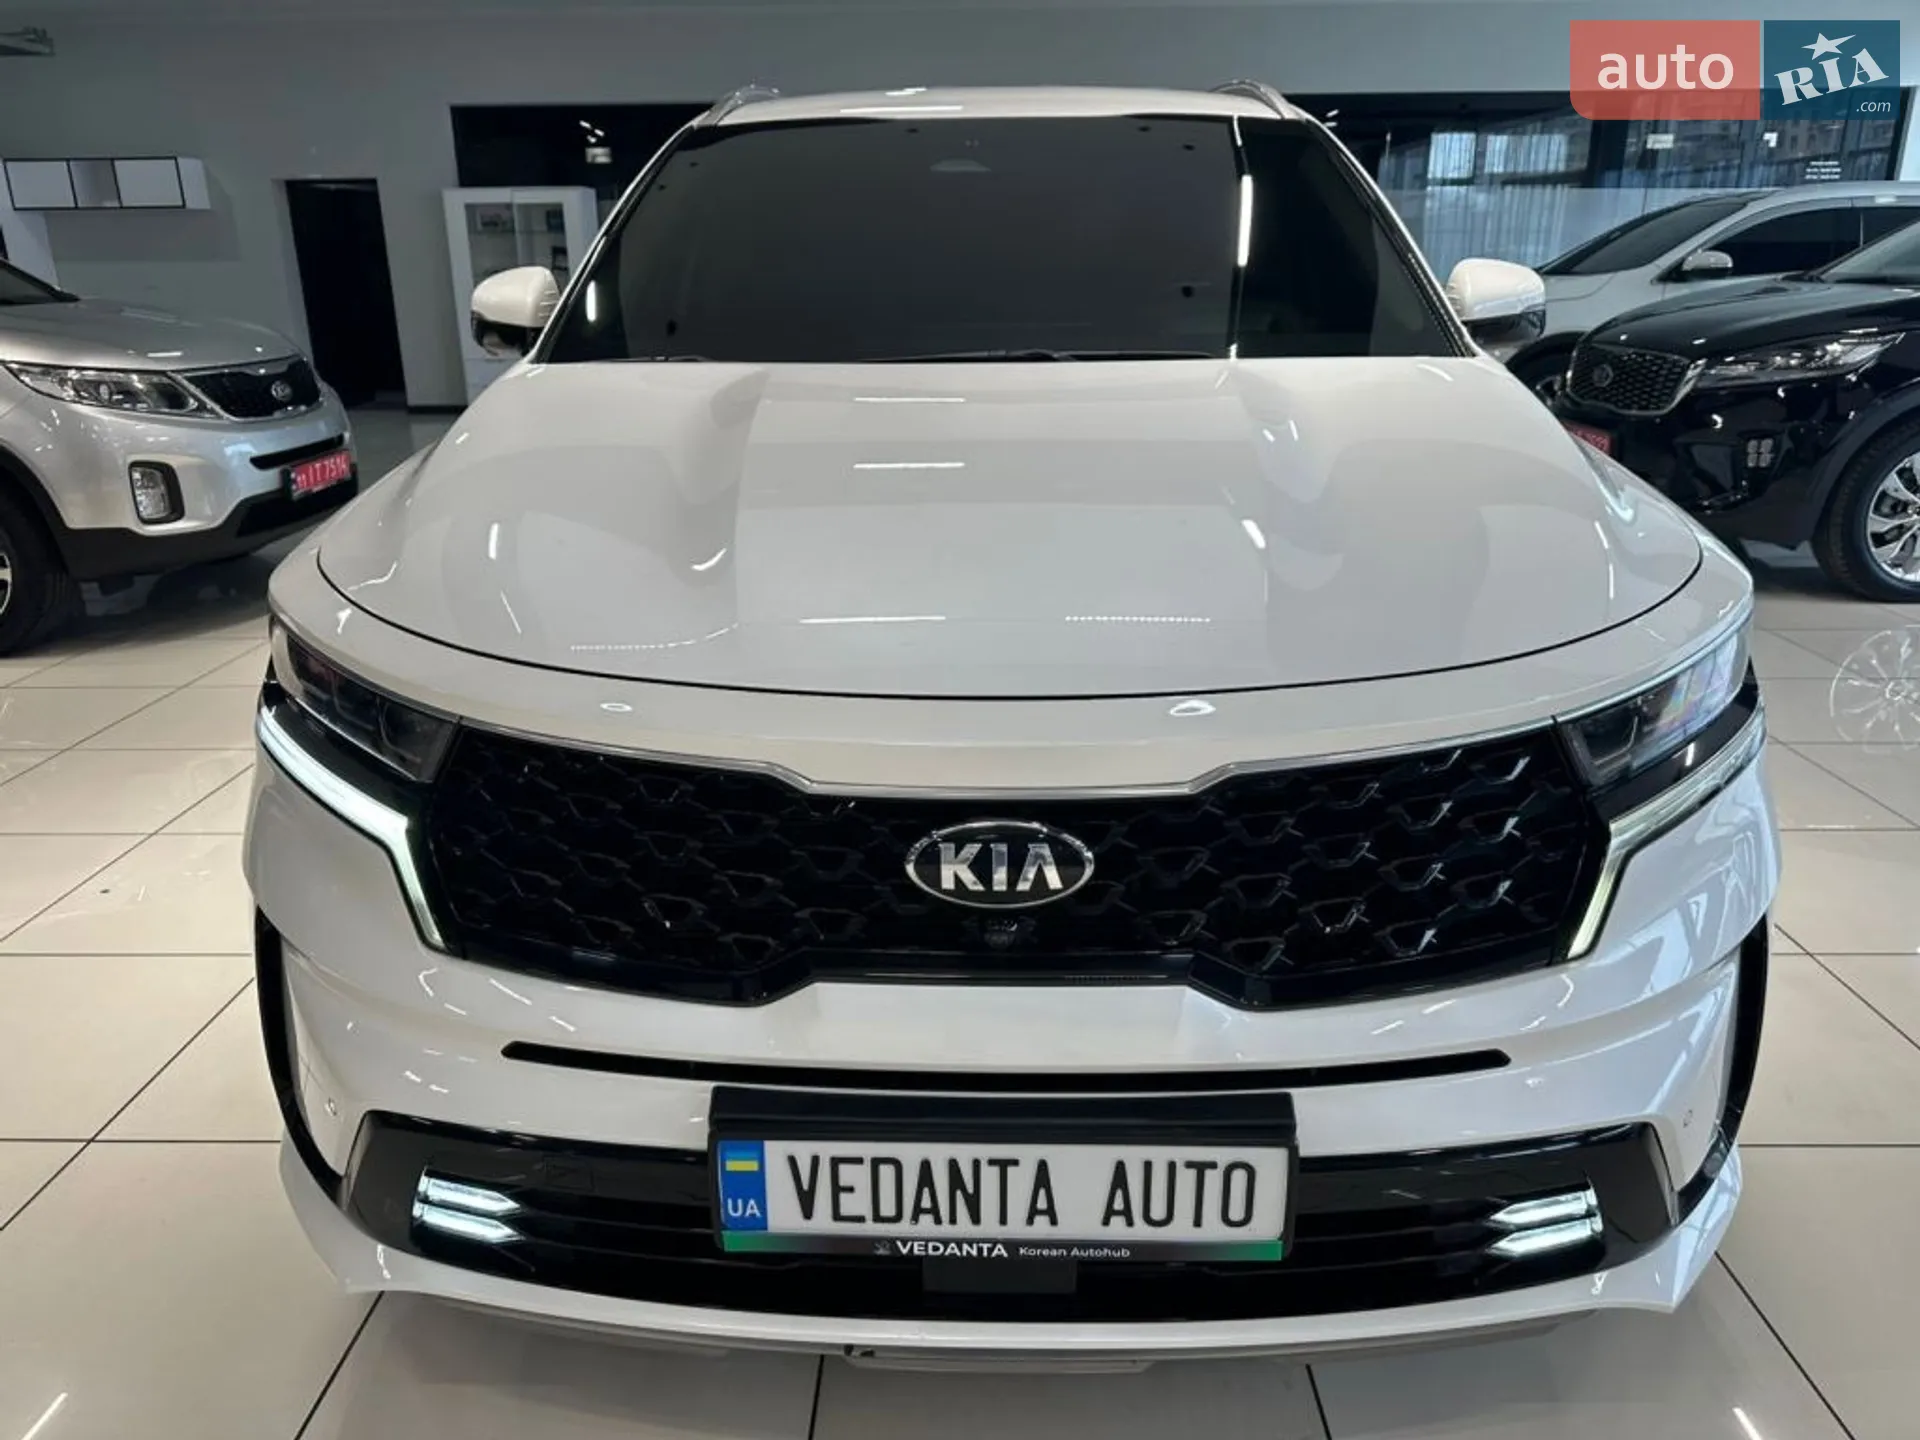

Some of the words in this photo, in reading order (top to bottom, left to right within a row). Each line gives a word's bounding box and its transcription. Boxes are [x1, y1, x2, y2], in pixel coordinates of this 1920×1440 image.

[938, 843, 1064, 891] KIA
[727, 1198, 762, 1218] UA
[787, 1154, 1059, 1227] VEDANTA
[1101, 1160, 1256, 1228] AUTO
[896, 1240, 1008, 1258] VEDANTA
[1019, 1246, 1066, 1257] Korean
[1070, 1246, 1130, 1258] Autohub
